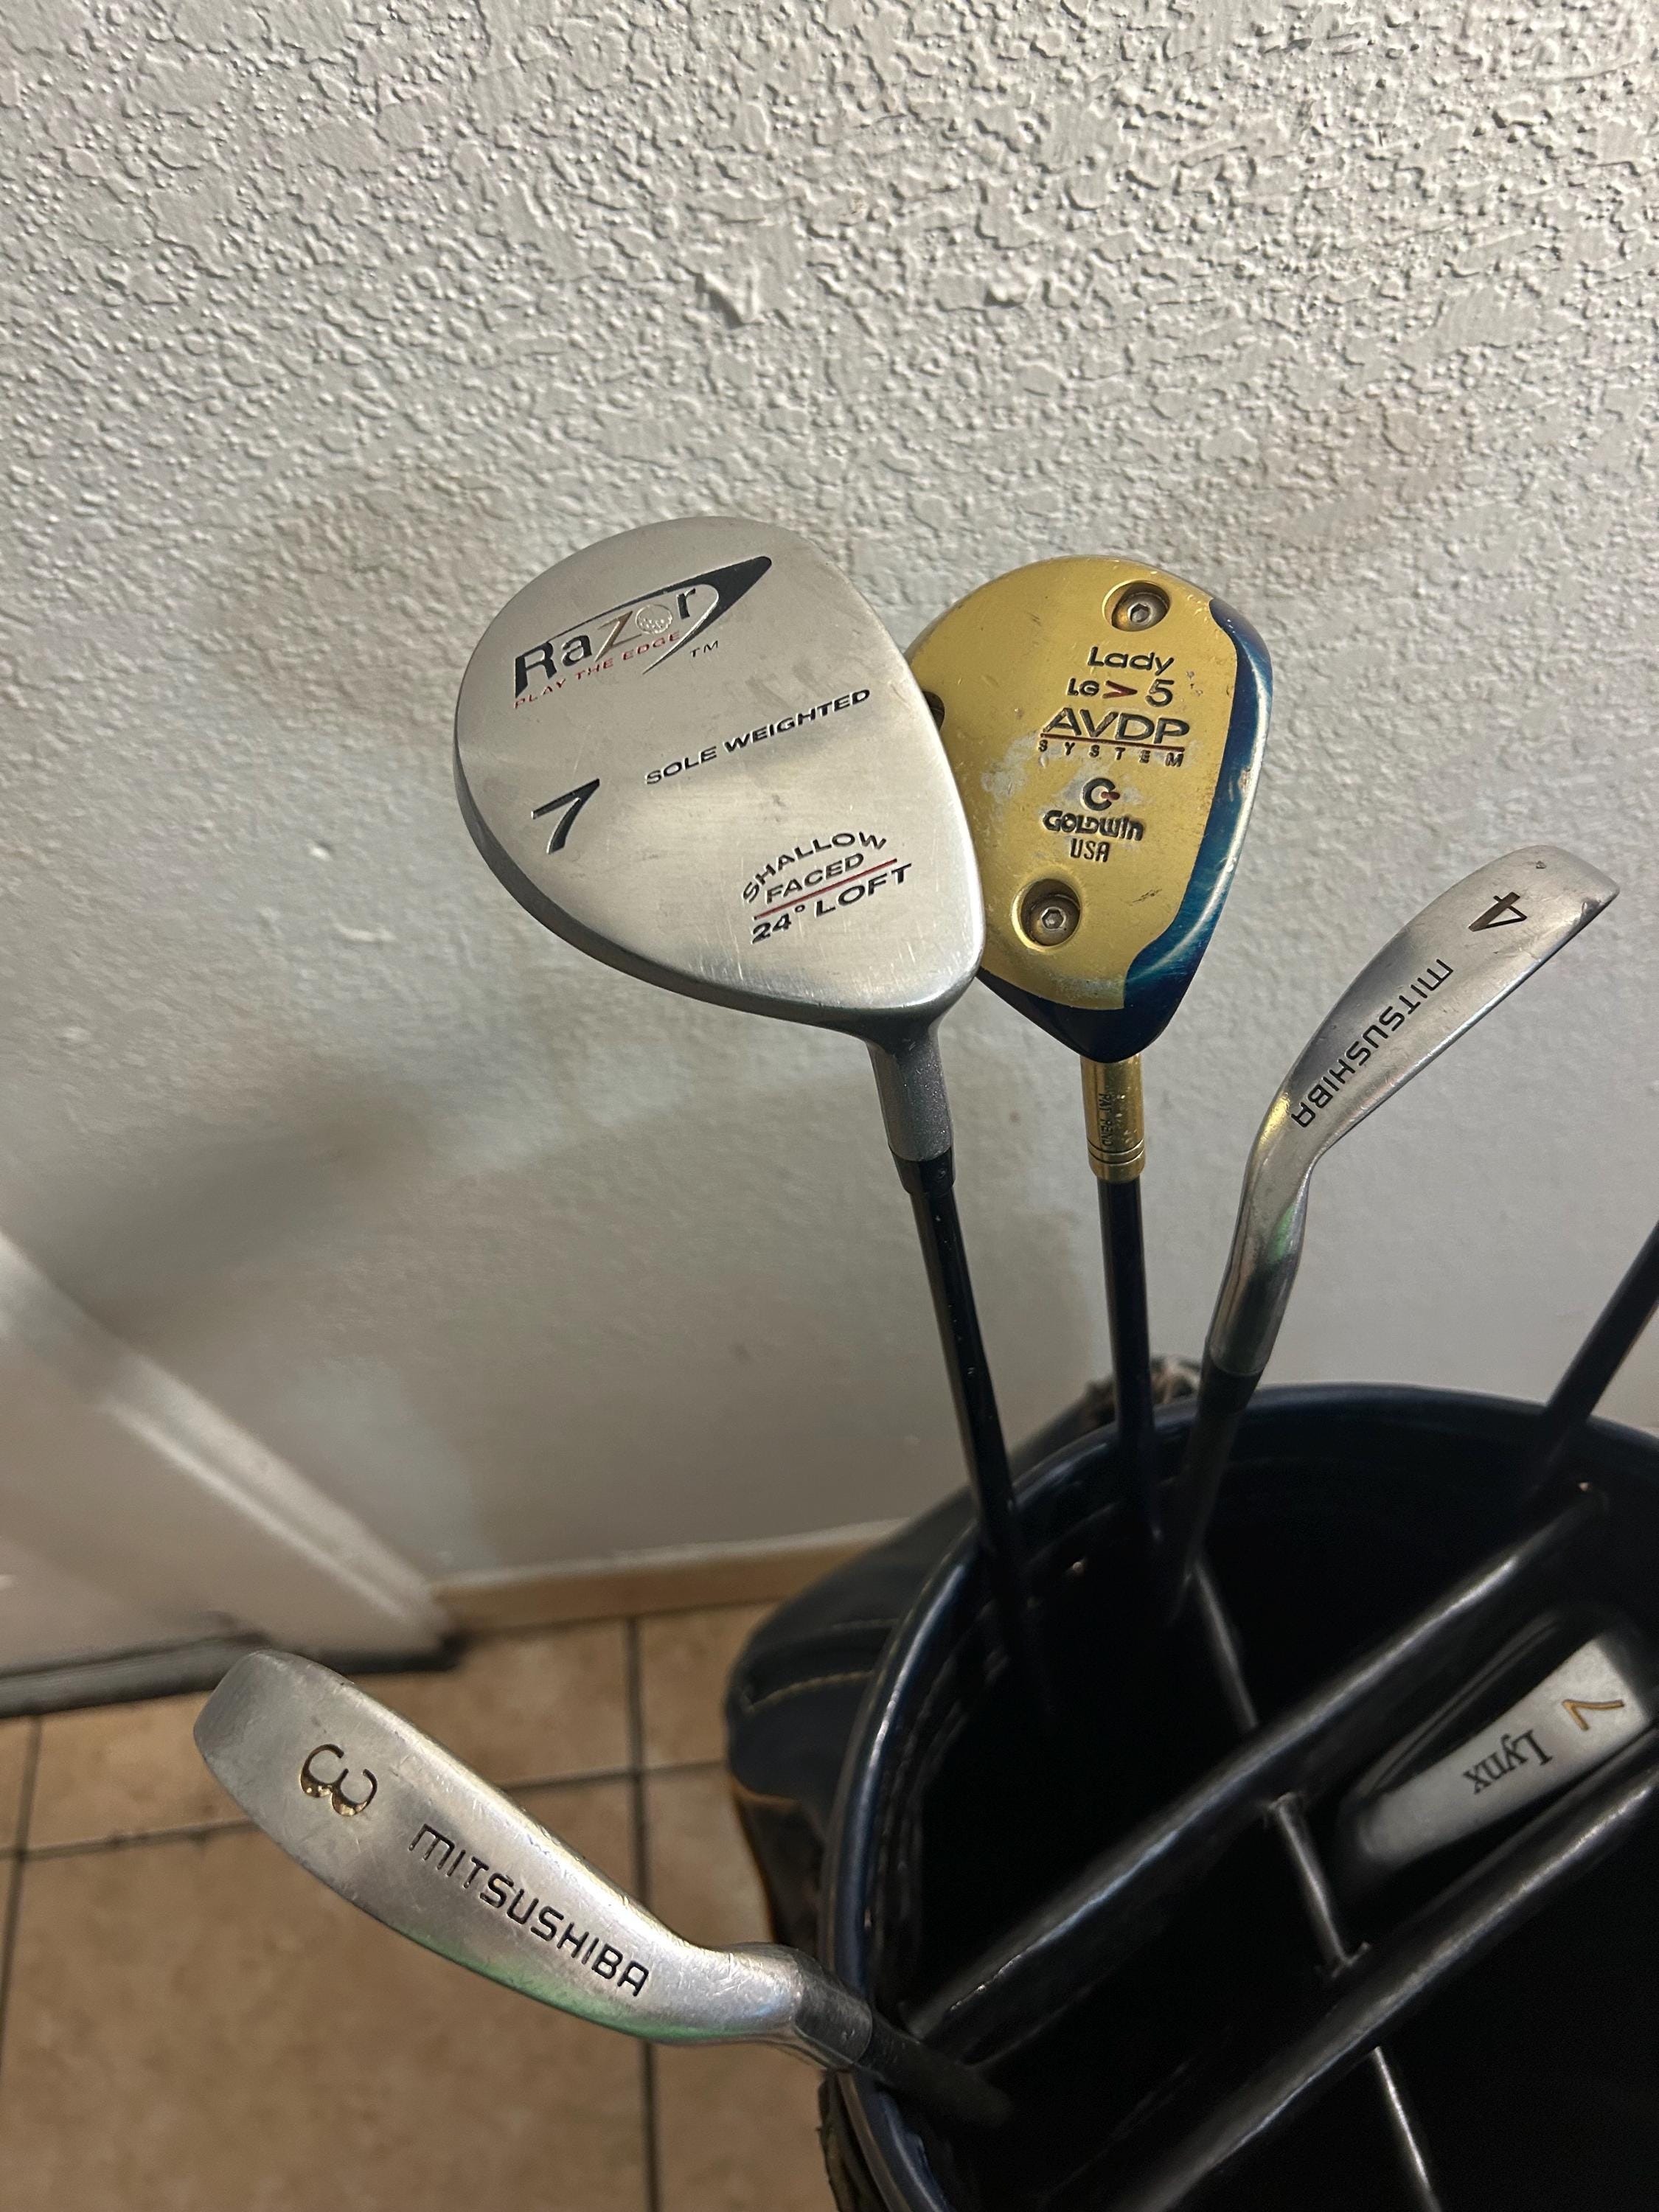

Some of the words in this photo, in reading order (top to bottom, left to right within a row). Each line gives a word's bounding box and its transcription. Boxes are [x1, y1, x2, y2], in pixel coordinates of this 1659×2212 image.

[513, 678, 566, 709] PLAY
[575, 658, 613, 680] THE
[622, 630, 681, 661] EDGE
[690, 640, 720, 658] TM
[1088, 646, 1174, 675] Lady
[1145, 679, 1175, 708] 5
[644, 746, 717, 785] SOLE
[723, 689, 871, 752] WEIGHTED
[1038, 740, 1184, 768] SYSTEM
[1043, 706, 1190, 745] AVDP
[531, 779, 600, 854] 7
[742, 831, 886, 904] SHALLOW
[765, 852, 864, 905] FACED
[1071, 838, 1110, 863] USA
[751, 904, 806, 945] 24°
[814, 863, 912, 918] LOFT
[1467, 891, 1528, 933] 4
[1290, 959, 1454, 1129] MITSUSHIBA
[1562, 1699, 1626, 1731] 7
[300, 1743, 378, 1818] 3
[1461, 1730, 1554, 1795] Lynx
[408, 1823, 650, 1998] MITSUSHIBA
